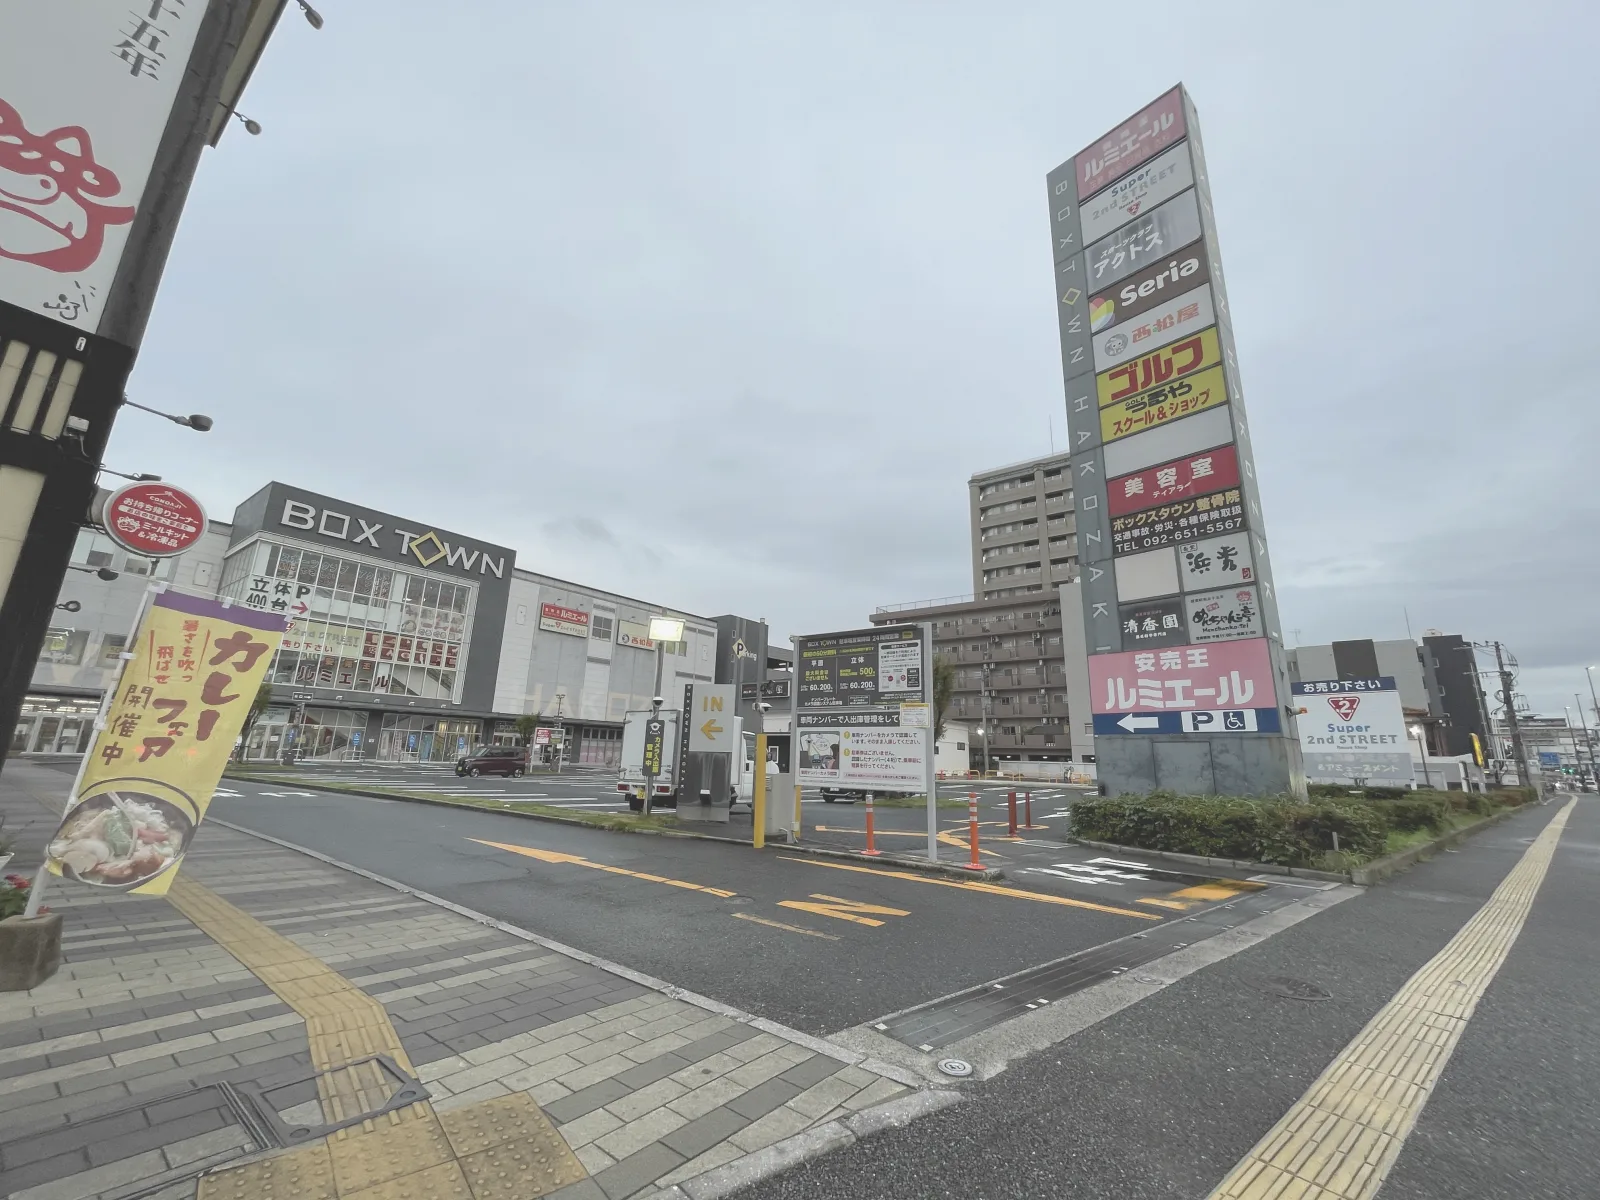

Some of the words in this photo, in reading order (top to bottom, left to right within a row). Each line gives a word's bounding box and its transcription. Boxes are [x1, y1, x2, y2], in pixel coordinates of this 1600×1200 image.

[1085, 111, 1175, 183] ルミエール
[1092, 199, 1119, 221] 2nd
[1121, 162, 1177, 203] STREET
[1111, 168, 1152, 198] Super
[1094, 232, 1164, 278] アクトス
[1120, 257, 1199, 307] Seria
[1132, 303, 1200, 344] 西松屋
[1109, 336, 1204, 401] ゴルフ
[1055, 179, 1074, 249] BOX
[1074, 395, 1112, 651] HAKOZAKI
[1125, 381, 1193, 414] つるや
[1125, 396, 1146, 407] GOLF
[1124, 456, 1214, 498] 美容室
[123, 497, 199, 524] お持ち帰りコーナー
[1113, 490, 1241, 531] ボックスタウン整骨院
[142, 521, 190, 540] ミールキット
[281, 499, 383, 548] BOX
[395, 530, 505, 579] TOWN
[1116, 541, 1139, 553] TEL
[1144, 518, 1243, 547] 092-651-5567
[1123, 613, 1179, 633] 清香園
[153, 646, 175, 684] 飛ばせ
[178, 620, 199, 682] 暑さを吹っ
[851, 656, 865, 664] 立体
[1134, 648, 1209, 673] 安売王
[197, 631, 269, 741] カレー
[297, 665, 389, 688] ルミエール
[1105, 670, 1254, 710] ルミエール
[1303, 680, 1381, 693] お売り下さい
[703, 696, 724, 712] IN
[800, 715, 900, 725] 車両ナンバーで入出庫管理をして
[1192, 712, 1214, 731] P
[102, 683, 154, 766] 開催中
[138, 698, 189, 762] フェア
[1307, 735, 1335, 745] 2nd
[1340, 734, 1398, 744] STREET
[1327, 723, 1371, 734] Super
